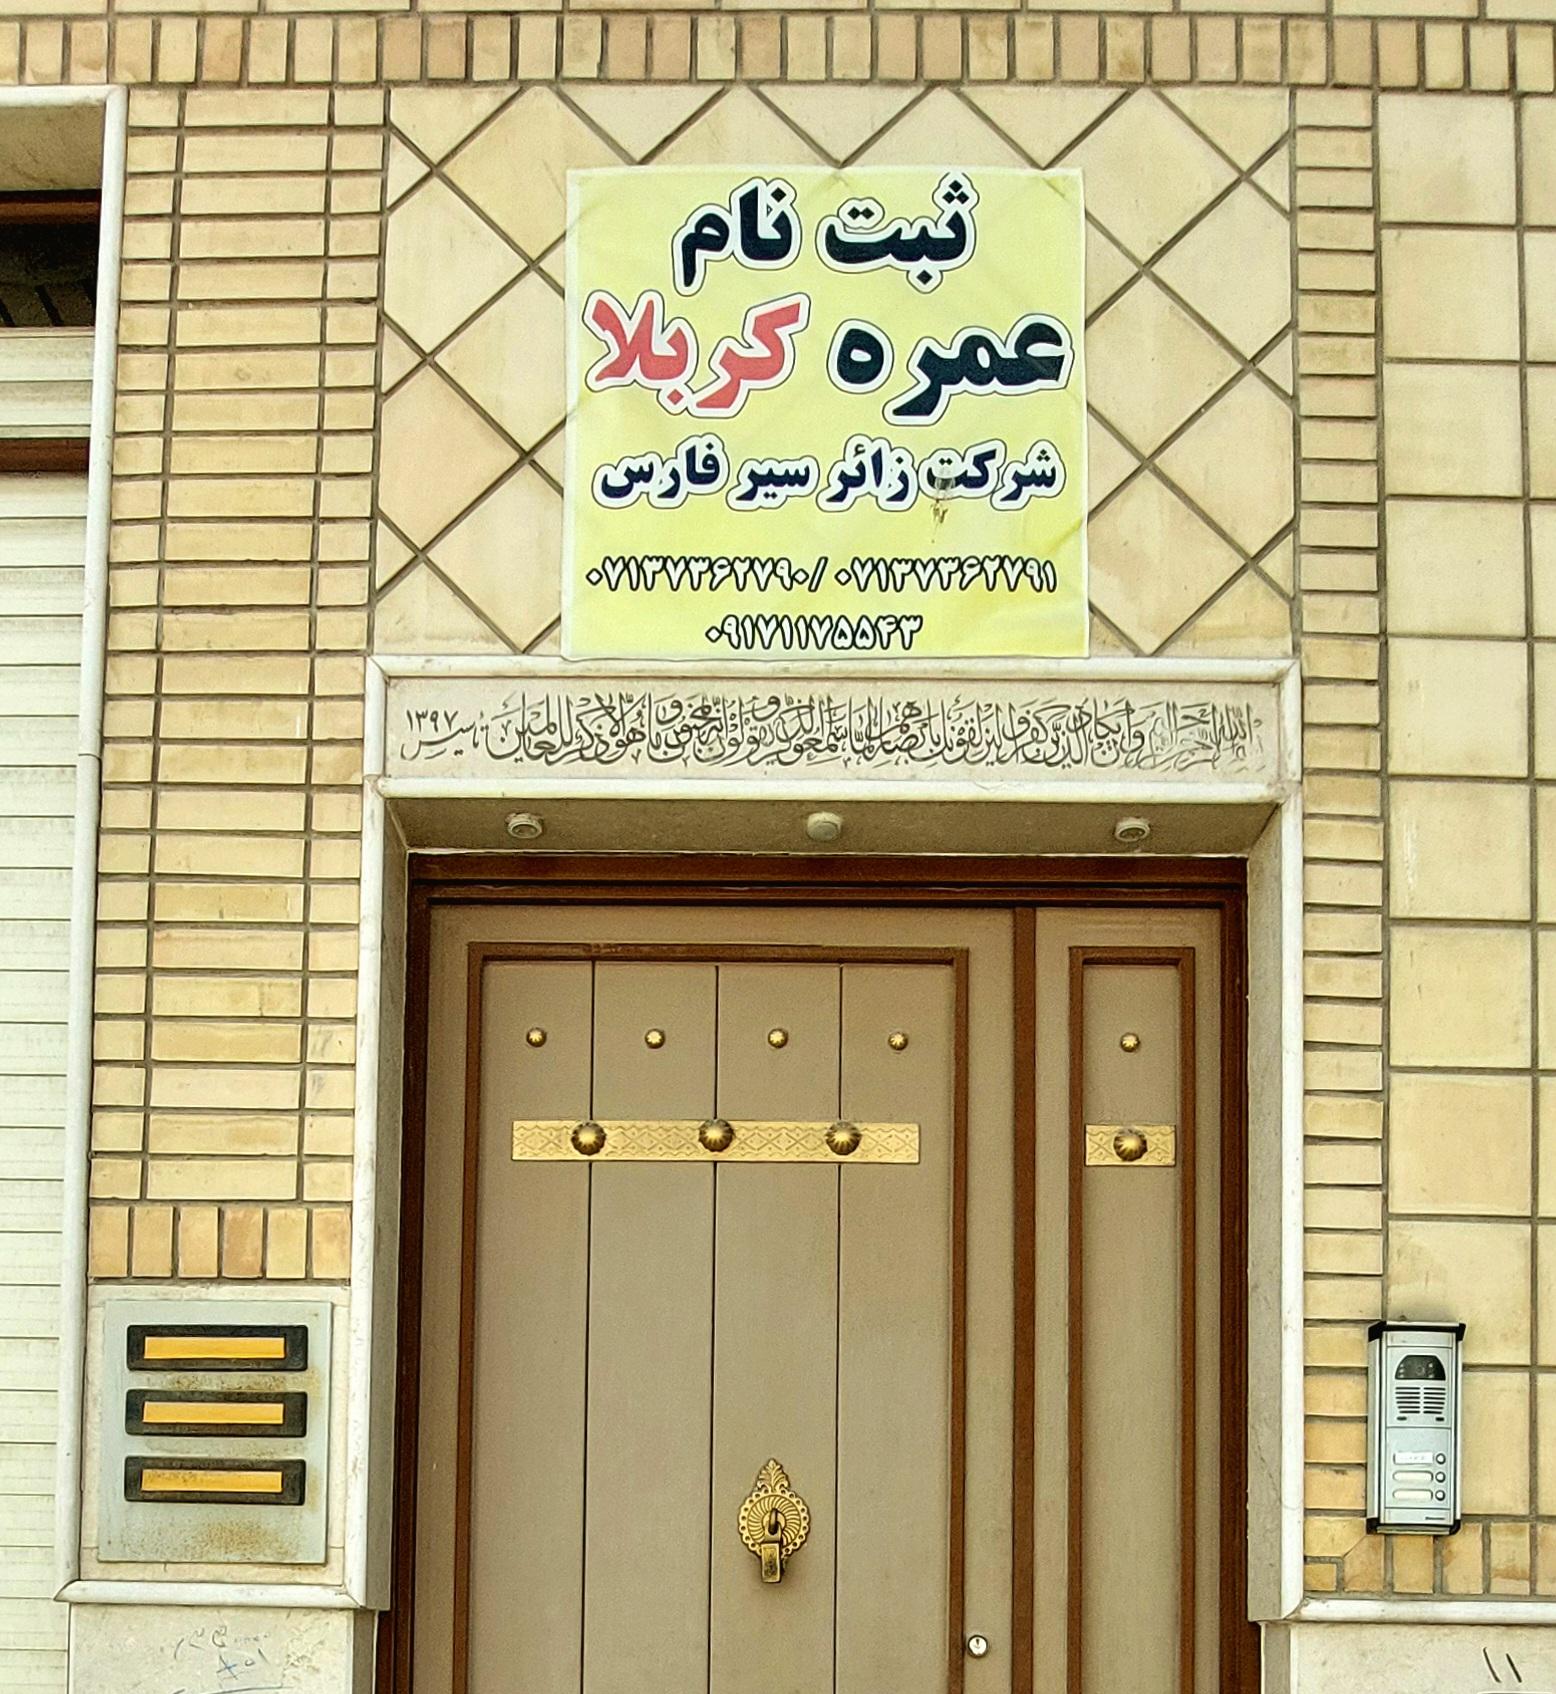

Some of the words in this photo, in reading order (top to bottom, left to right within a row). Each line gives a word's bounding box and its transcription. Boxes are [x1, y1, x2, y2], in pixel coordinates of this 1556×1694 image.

[680, 184, 794, 288] نام
[822, 177, 970, 286] ثبت
[590, 298, 802, 410] کربلا
[836, 322, 1066, 419] عمره
[600, 440, 722, 501] فارس
[735, 458, 811, 502] سیر
[826, 442, 910, 502] زائر
[925, 448, 1057, 502] شرکت
[835, 554, 1057, 593] ۰۷۱۳۷۳۶۲۷۹۱
[705, 614, 923, 650] ۰۹۱۷۱۱۷۵۵۴۳
[406, 707, 460, 733] ۱۳۹۷
